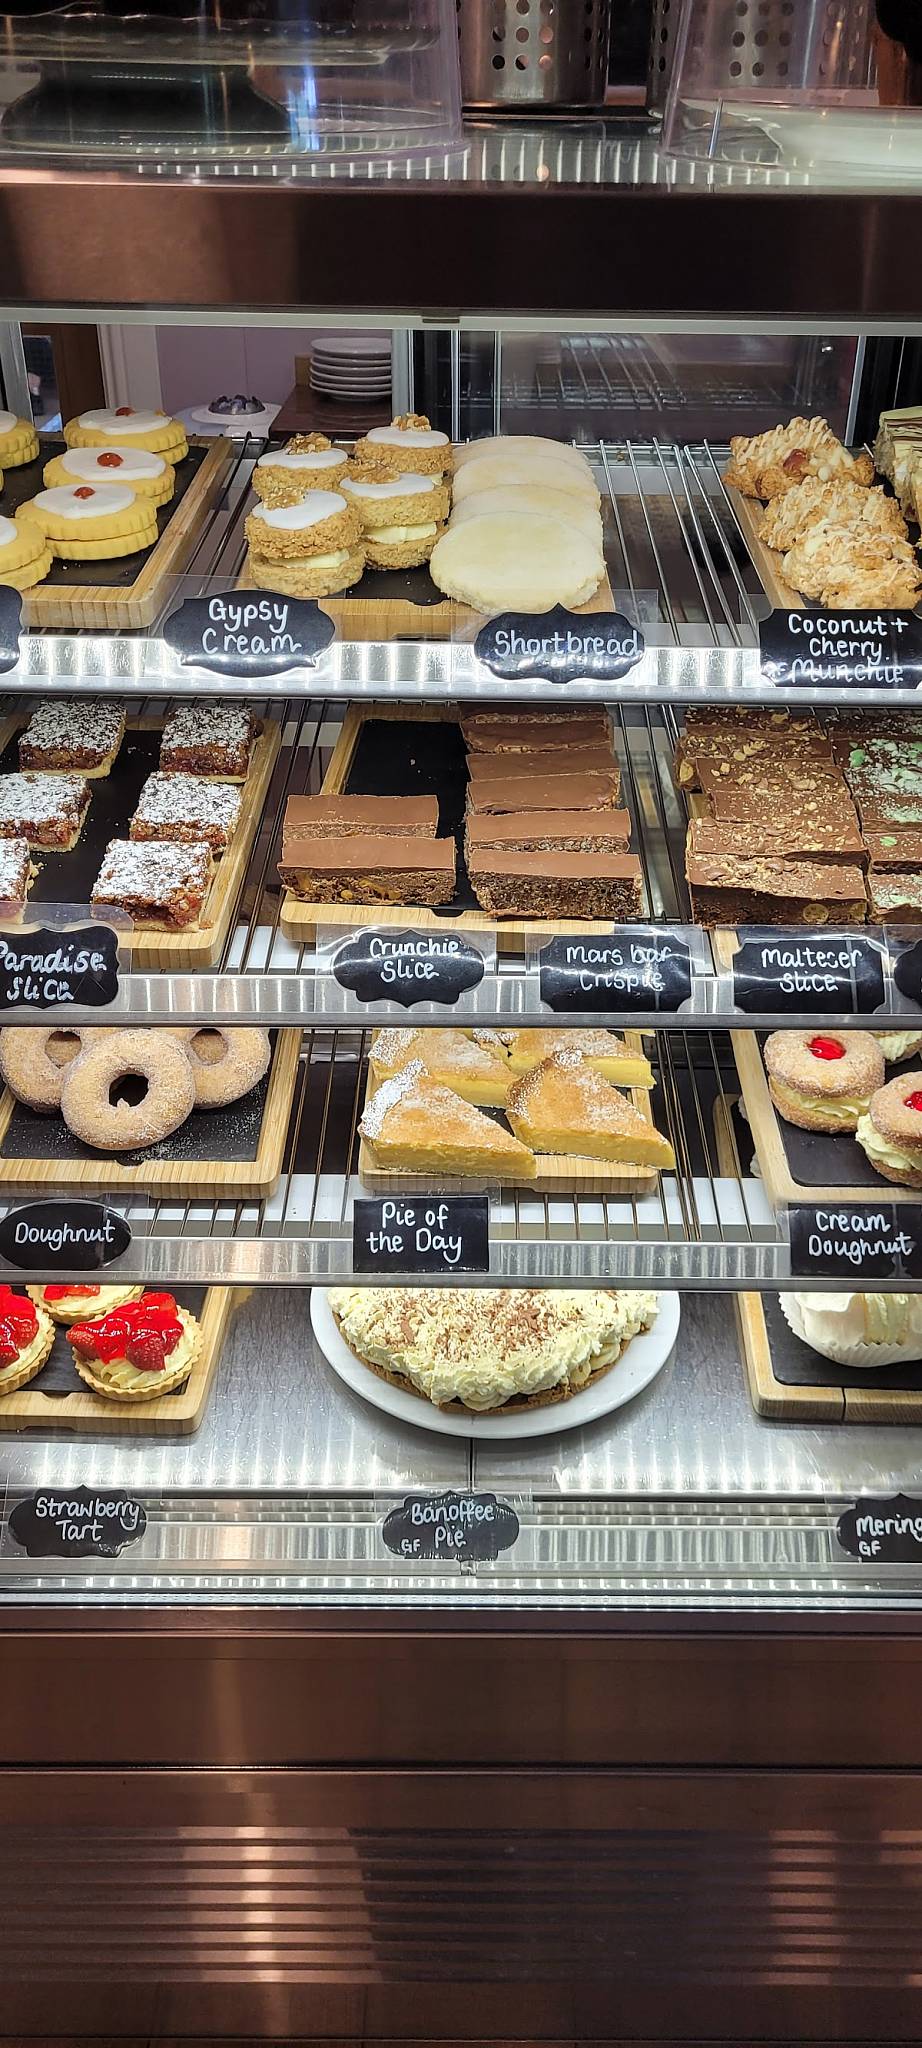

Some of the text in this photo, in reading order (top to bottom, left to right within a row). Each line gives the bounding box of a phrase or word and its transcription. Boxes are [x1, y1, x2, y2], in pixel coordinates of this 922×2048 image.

[208, 598, 289, 634] Gypsy
[201, 627, 302, 655] Cream
[494, 629, 640, 658] Shortbread
[809, 636, 882, 666] Cherry
[790, 655, 904, 684] Munchie
[369, 937, 461, 959] Crunchie
[380, 958, 440, 983] Slice
[382, 1201, 449, 1230] Pie of
[815, 1210, 892, 1233] Cream
[14, 1219, 116, 1251] Doughnut
[365, 1227, 462, 1264] the Day
[808, 1231, 913, 1265] Doughnut
[35, 1496, 140, 1531] Strawberry
[411, 1500, 496, 1526] Banoffee
[55, 1519, 104, 1541] Tart
[400, 1525, 467, 1553] GF Pie
[858, 1540, 882, 1557] GF
